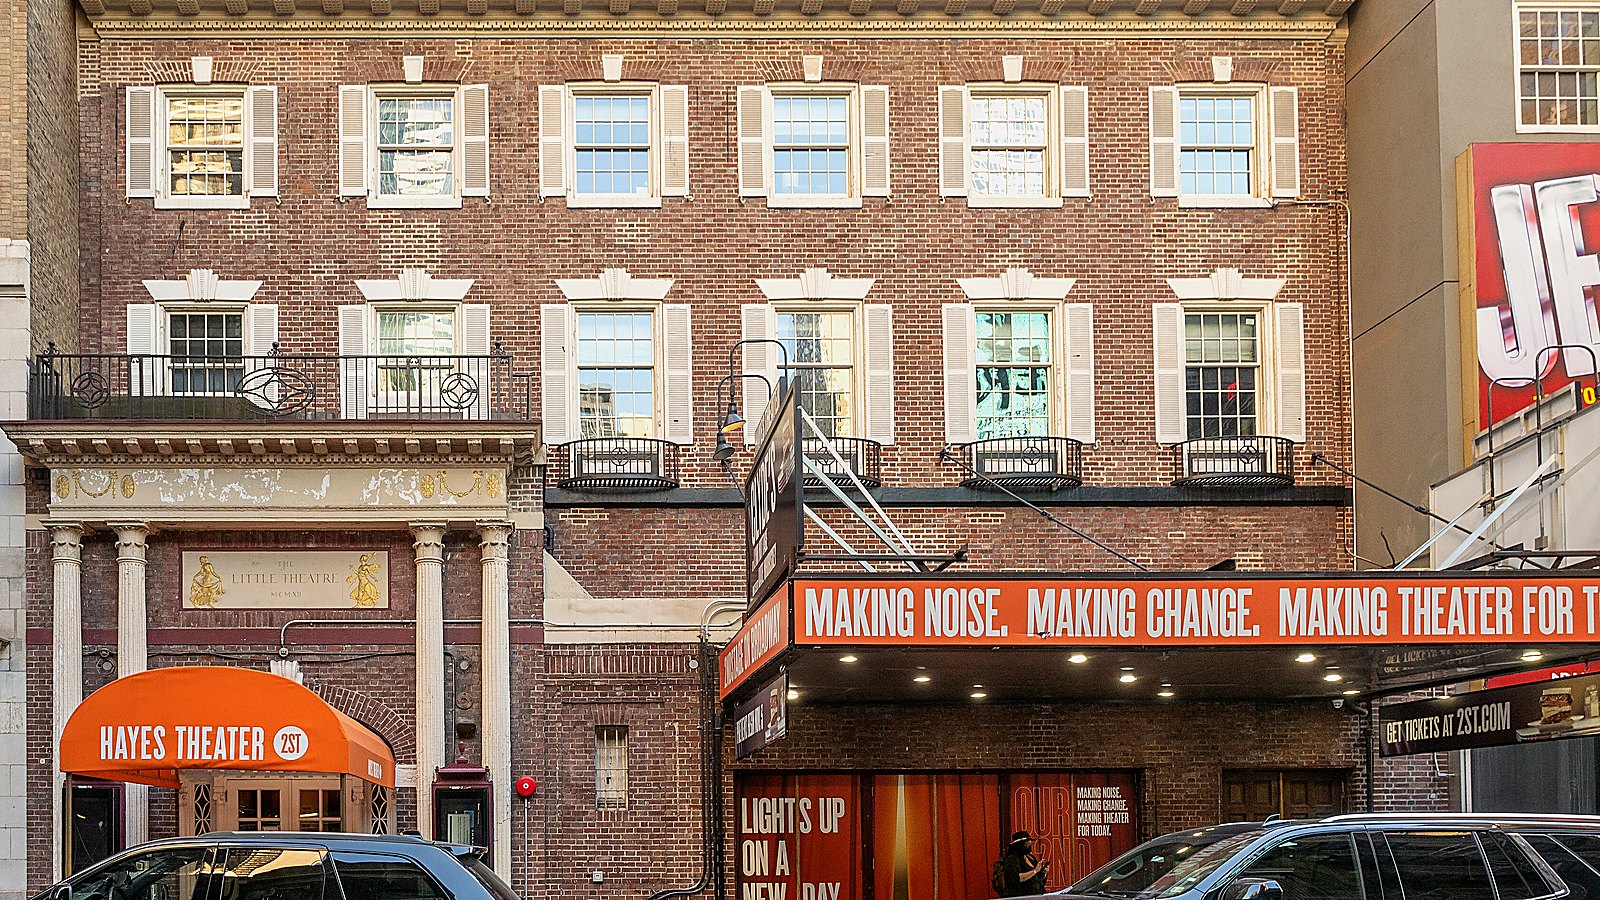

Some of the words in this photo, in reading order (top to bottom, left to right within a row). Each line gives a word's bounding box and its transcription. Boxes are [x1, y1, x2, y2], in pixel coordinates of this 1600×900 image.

[232, 573, 278, 584] LITTLE
[282, 573, 340, 584] THEATRE
[805, 587, 914, 638] MAKING
[924, 587, 1008, 638] NOISE.
[1027, 587, 1136, 638] MAKING
[1146, 586, 1260, 638] CHANGE.
[1279, 586, 1388, 637] MAKING
[1397, 586, 1513, 636] THEATER
[1523, 585, 1574, 635] FOR
[1386, 721, 1402, 744] GET
[1404, 716, 1439, 741] TICKETS
[1442, 714, 1454, 738] AT
[1456, 702, 1511, 736] 2ST.COM
[100, 725, 166, 760] HAYES
[175, 725, 265, 761] THEATER
[280, 733, 302, 754] 2ST
[1077, 787, 1101, 798] MAKING
[1102, 787, 1121, 798] NOISE.
[1077, 800, 1101, 811] MAKING
[1103, 800, 1128, 811] CHANGE.
[741, 797, 812, 834] LIGHTS
[819, 797, 845, 834] UP
[1014, 786, 1071, 837] OUR
[1077, 812, 1101, 823] MAKING
[1103, 812, 1129, 823] THEATER
[1077, 825, 1089, 836] FOR
[1091, 825, 1111, 836] TODAY.
[742, 840, 768, 877] ON
[775, 840, 790, 876] A
